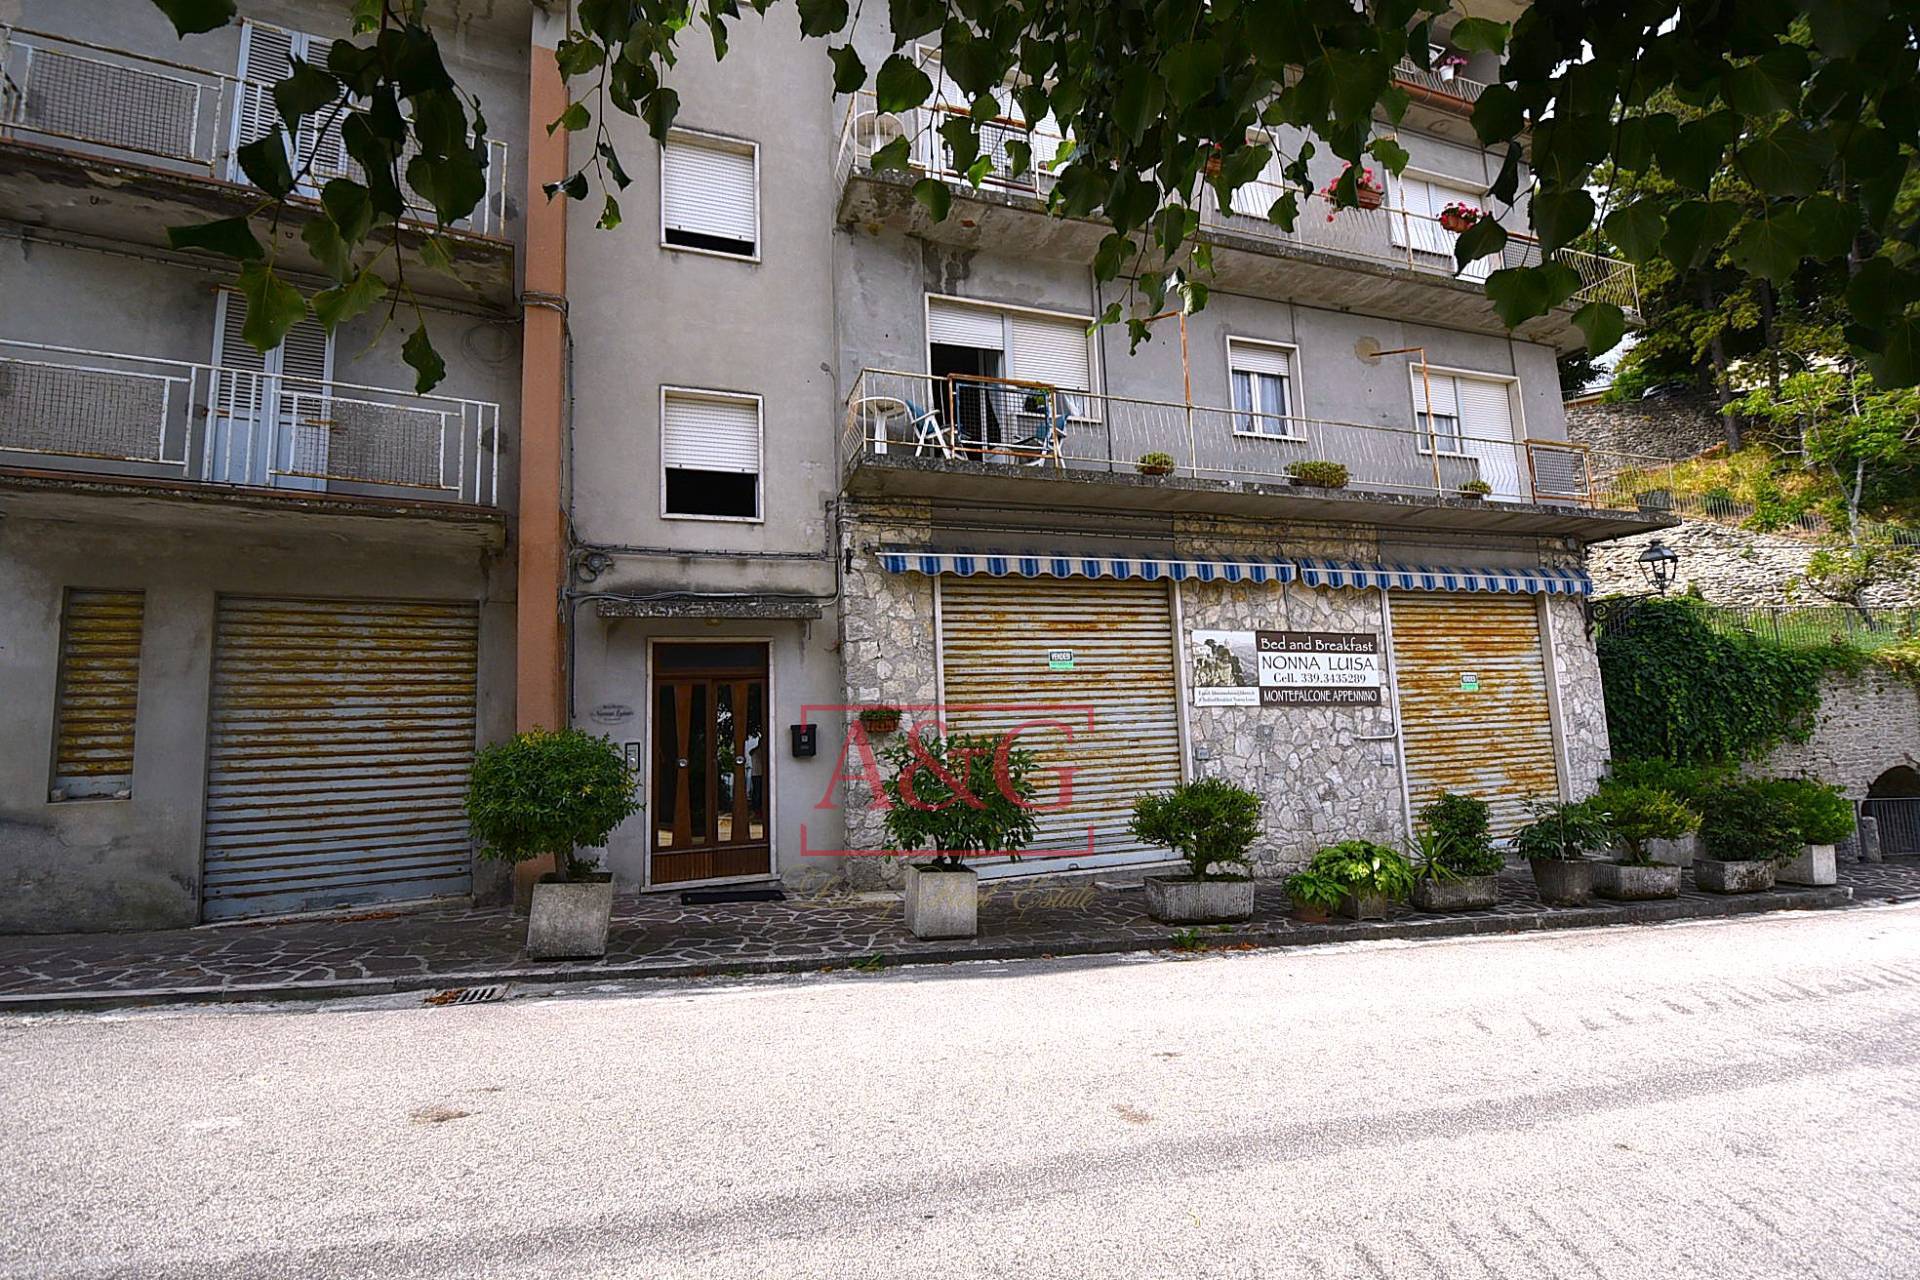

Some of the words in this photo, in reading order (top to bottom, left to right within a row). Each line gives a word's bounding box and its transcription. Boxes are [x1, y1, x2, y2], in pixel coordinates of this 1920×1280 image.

[1260, 634, 1286, 650] Bed
[1289, 635, 1312, 651] and
[1315, 636, 1373, 652] Breakfast
[1262, 655, 1321, 670] NONNA
[1328, 656, 1375, 671] LUISA
[1273, 672, 1297, 683] Cell.
[1301, 672, 1366, 684] 339.3435289
[1263, 689, 1333, 702] MONTEFALCONE
[1333, 690, 1377, 702] APPENNINO
